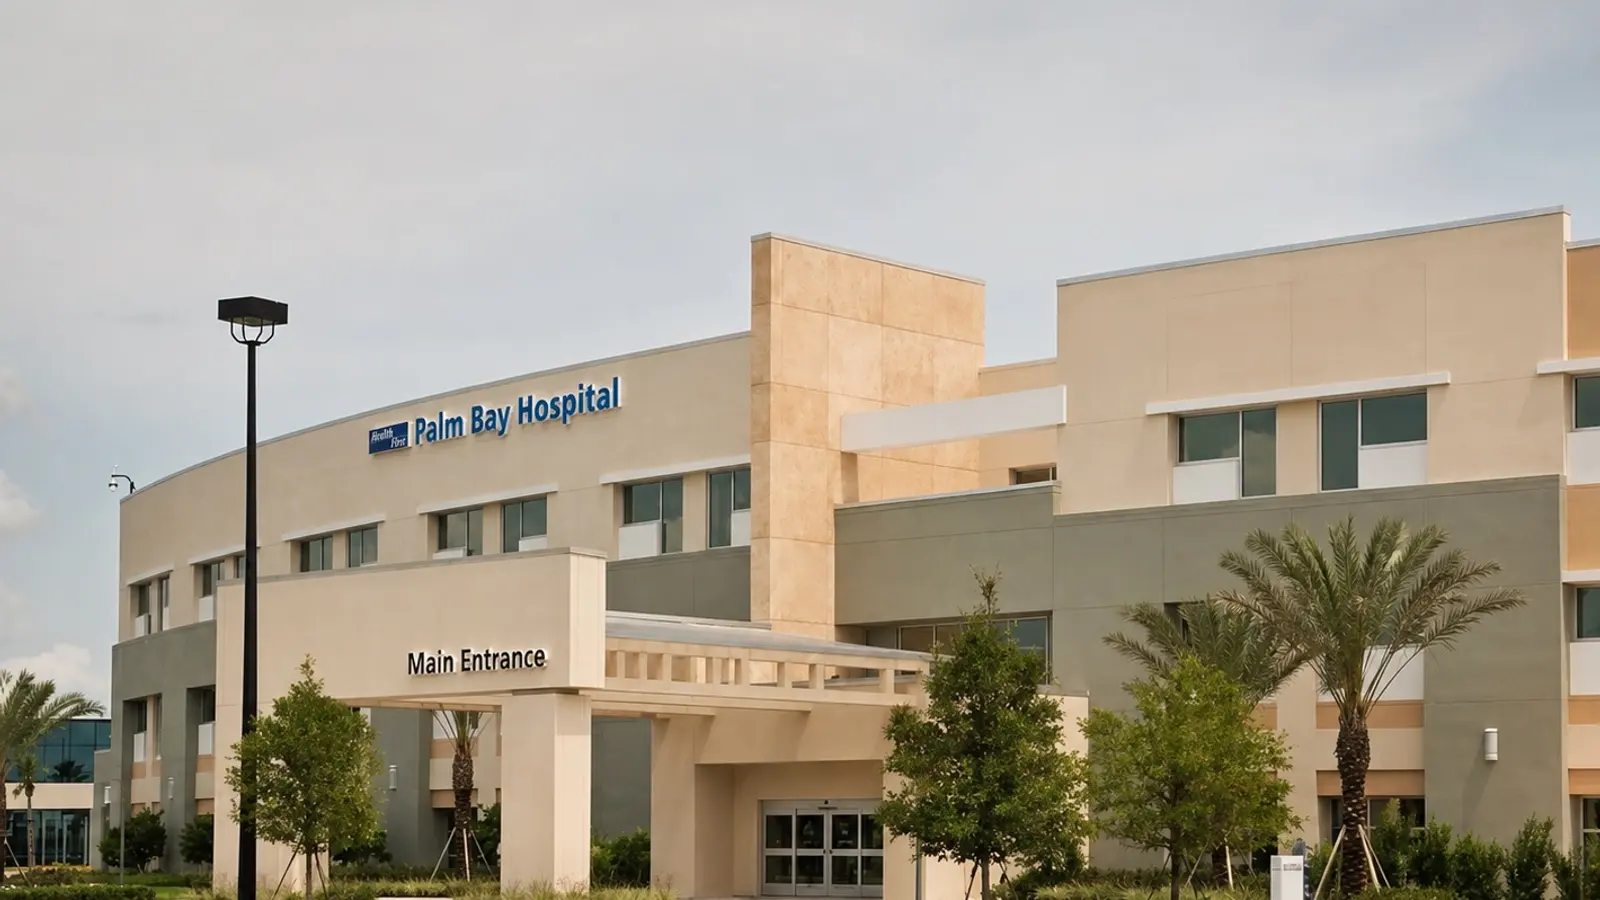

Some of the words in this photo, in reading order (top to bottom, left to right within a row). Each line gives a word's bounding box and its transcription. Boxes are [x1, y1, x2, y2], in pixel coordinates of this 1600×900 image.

[415, 411, 464, 445] Palm
[471, 405, 511, 436] Bay
[518, 376, 619, 425] Hospital
[371, 428, 393, 443] Health
[390, 437, 406, 448] First
[408, 649, 454, 675] Main
[461, 648, 546, 672] Entrance
